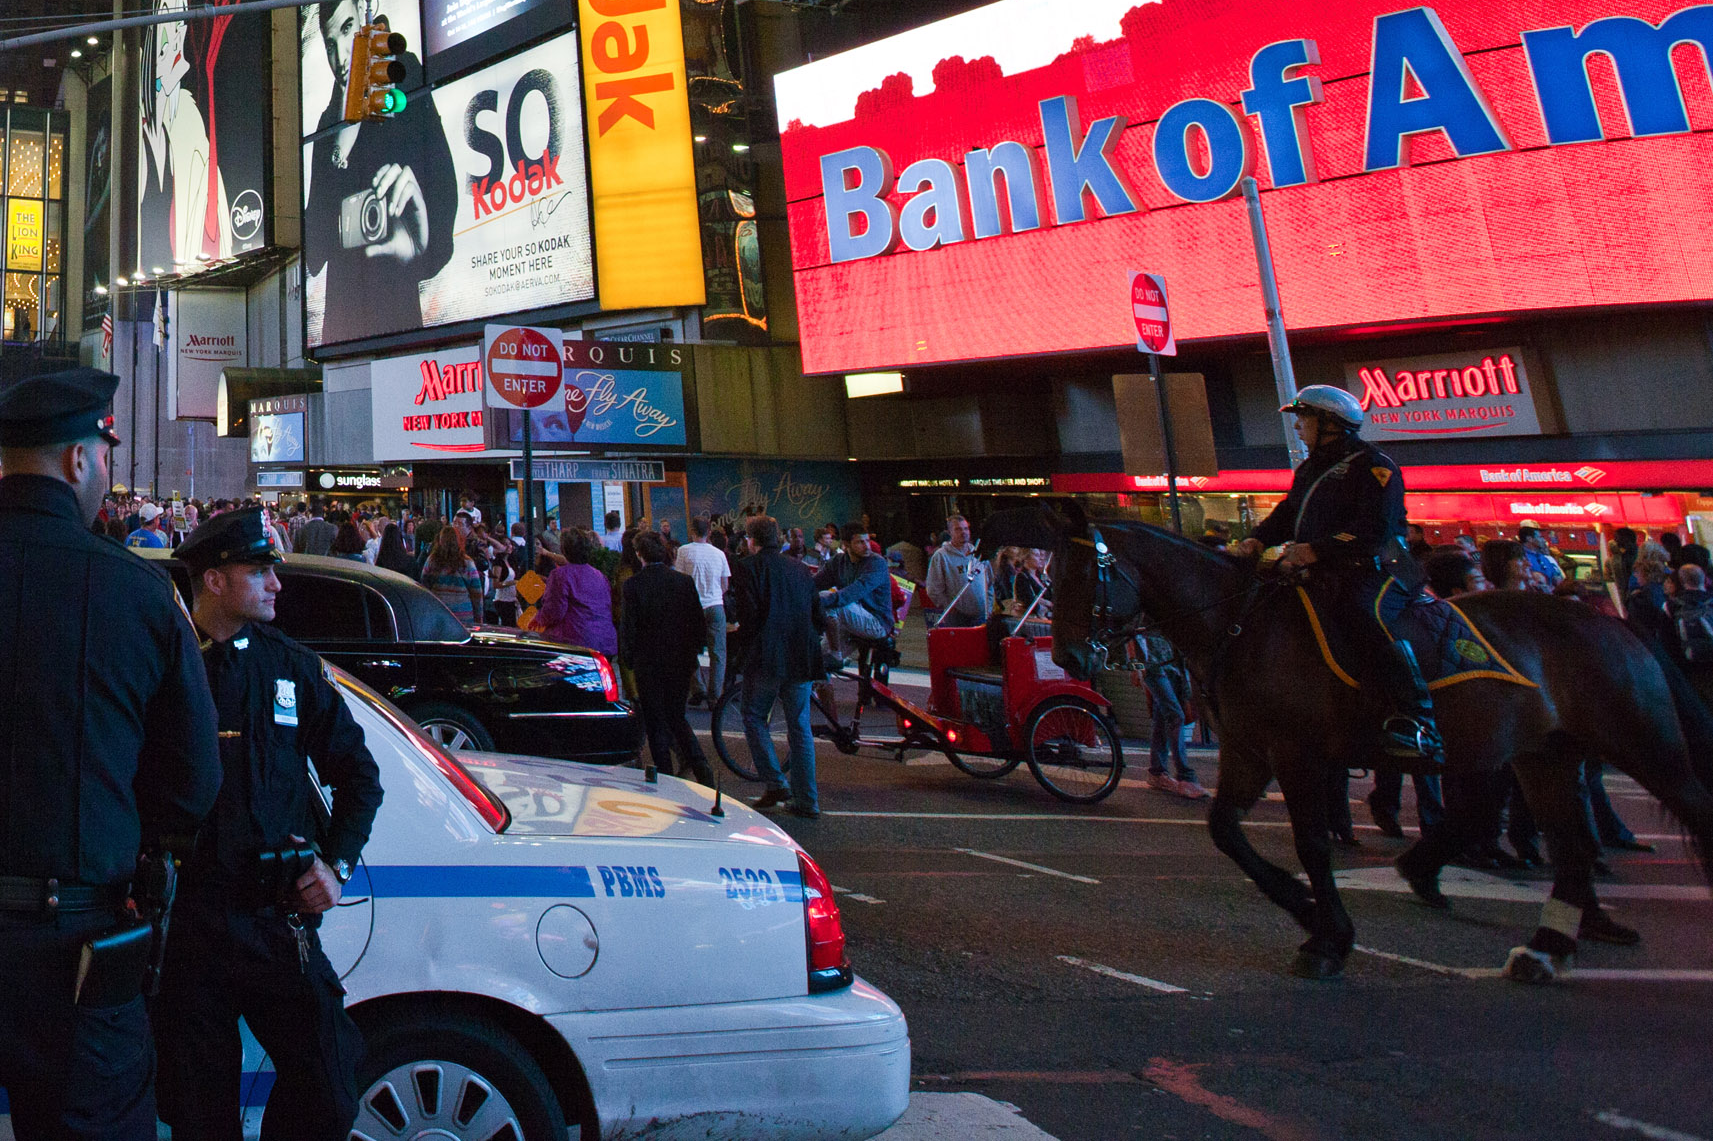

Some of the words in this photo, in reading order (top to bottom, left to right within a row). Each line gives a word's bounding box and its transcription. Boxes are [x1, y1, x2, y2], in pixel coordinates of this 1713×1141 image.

[446, 1, 458, 14] Join
[462, 68, 564, 197] SO
[819, 95, 1141, 264] Bank
[1153, 38, 1322, 205] of
[472, 148, 564, 220] Kodak
[16, 212, 35, 223] THE
[232, 205, 261, 228] Disney
[12, 226, 38, 241] LION
[11, 244, 39, 260] KING
[471, 251, 499, 269] SHARE
[500, 246, 523, 261] YOUR
[525, 242, 537, 256] SO
[538, 234, 570, 253] KODAK
[489, 261, 526, 281] MOMENT
[529, 255, 553, 272] HERE
[484, 273, 560, 297] SOKODAK@AERVA.COM
[1135, 287, 1144, 299] DO
[1145, 289, 1159, 303] NOT
[1142, 323, 1164, 338] ENTER
[186, 334, 235, 347] Marriott
[499, 342, 518, 356] DO
[522, 343, 548, 357] NOT
[220, 348, 242, 356] MARQUIS
[414, 360, 483, 405] Marri
[504, 378, 546, 393] ENTER
[1361, 354, 1520, 412] Marriott
[250, 399, 305, 414] MARQUIS
[569, 371, 618, 415] Fly
[616, 387, 677, 438] Away
[403, 415, 431, 431] NEW
[432, 411, 471, 430] YORK
[1371, 411, 1399, 425] NEW
[1403, 410, 1441, 423] YORK
[1446, 405, 1516, 422] MARQUIS
[545, 461, 579, 479] THARP
[591, 469, 610, 479] FRANK
[611, 462, 655, 480] SINATRA
[1480, 469, 1510, 483] Bank
[1510, 469, 1523, 483] of
[1522, 468, 1573, 482] America
[773, 472, 830, 519] Away
[1510, 502, 1535, 514] Bank
[1544, 503, 1584, 514] America
[596, 865, 666, 899] PBMS
[718, 866, 779, 902] 2522
